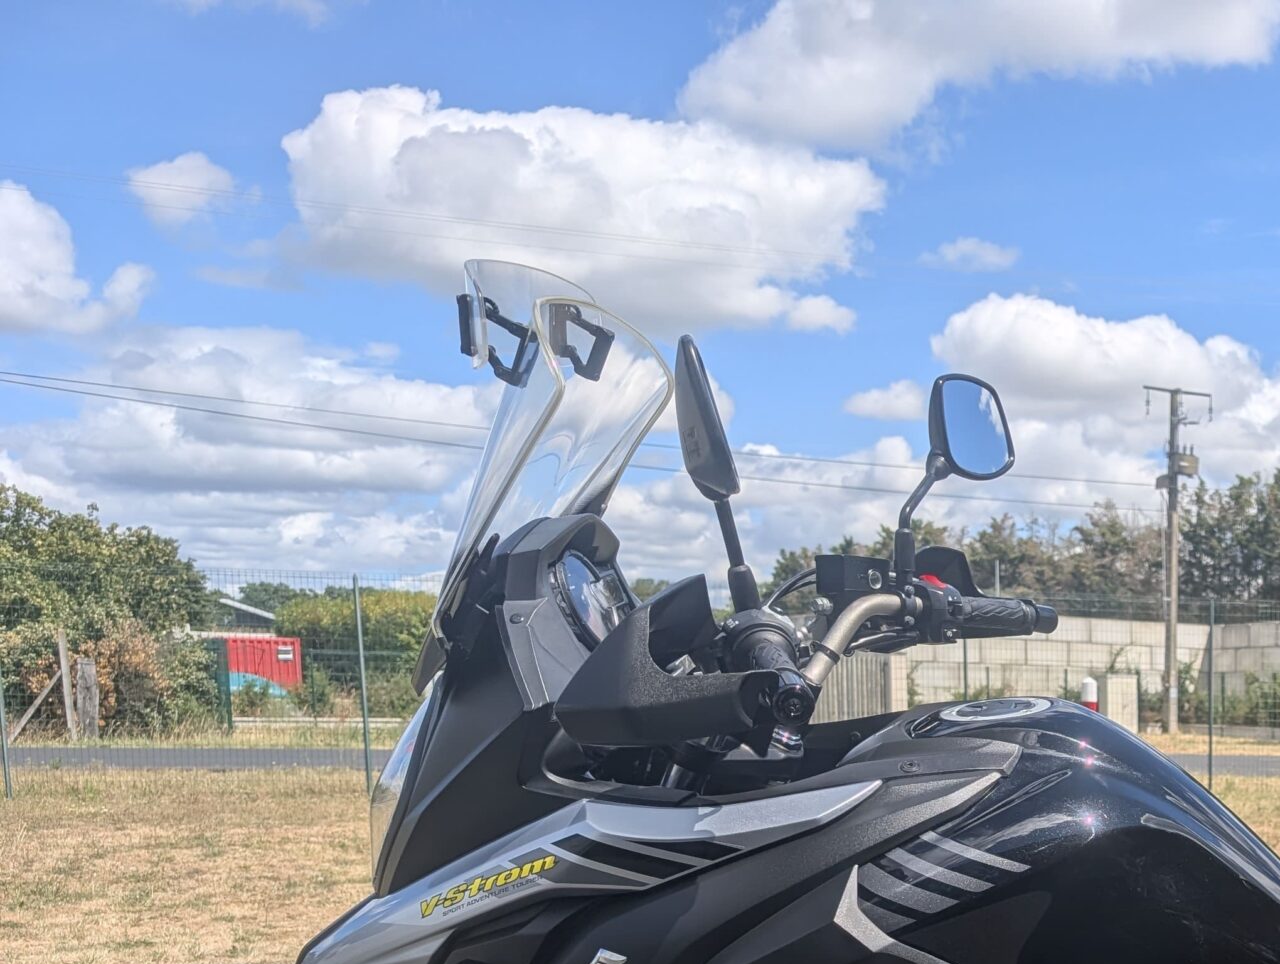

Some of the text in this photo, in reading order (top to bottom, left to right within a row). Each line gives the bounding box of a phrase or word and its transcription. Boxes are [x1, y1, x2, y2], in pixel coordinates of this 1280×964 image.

[420, 855, 557, 918] V-Strom
[442, 874, 543, 916] SPORT ADVENTURE TOURER
